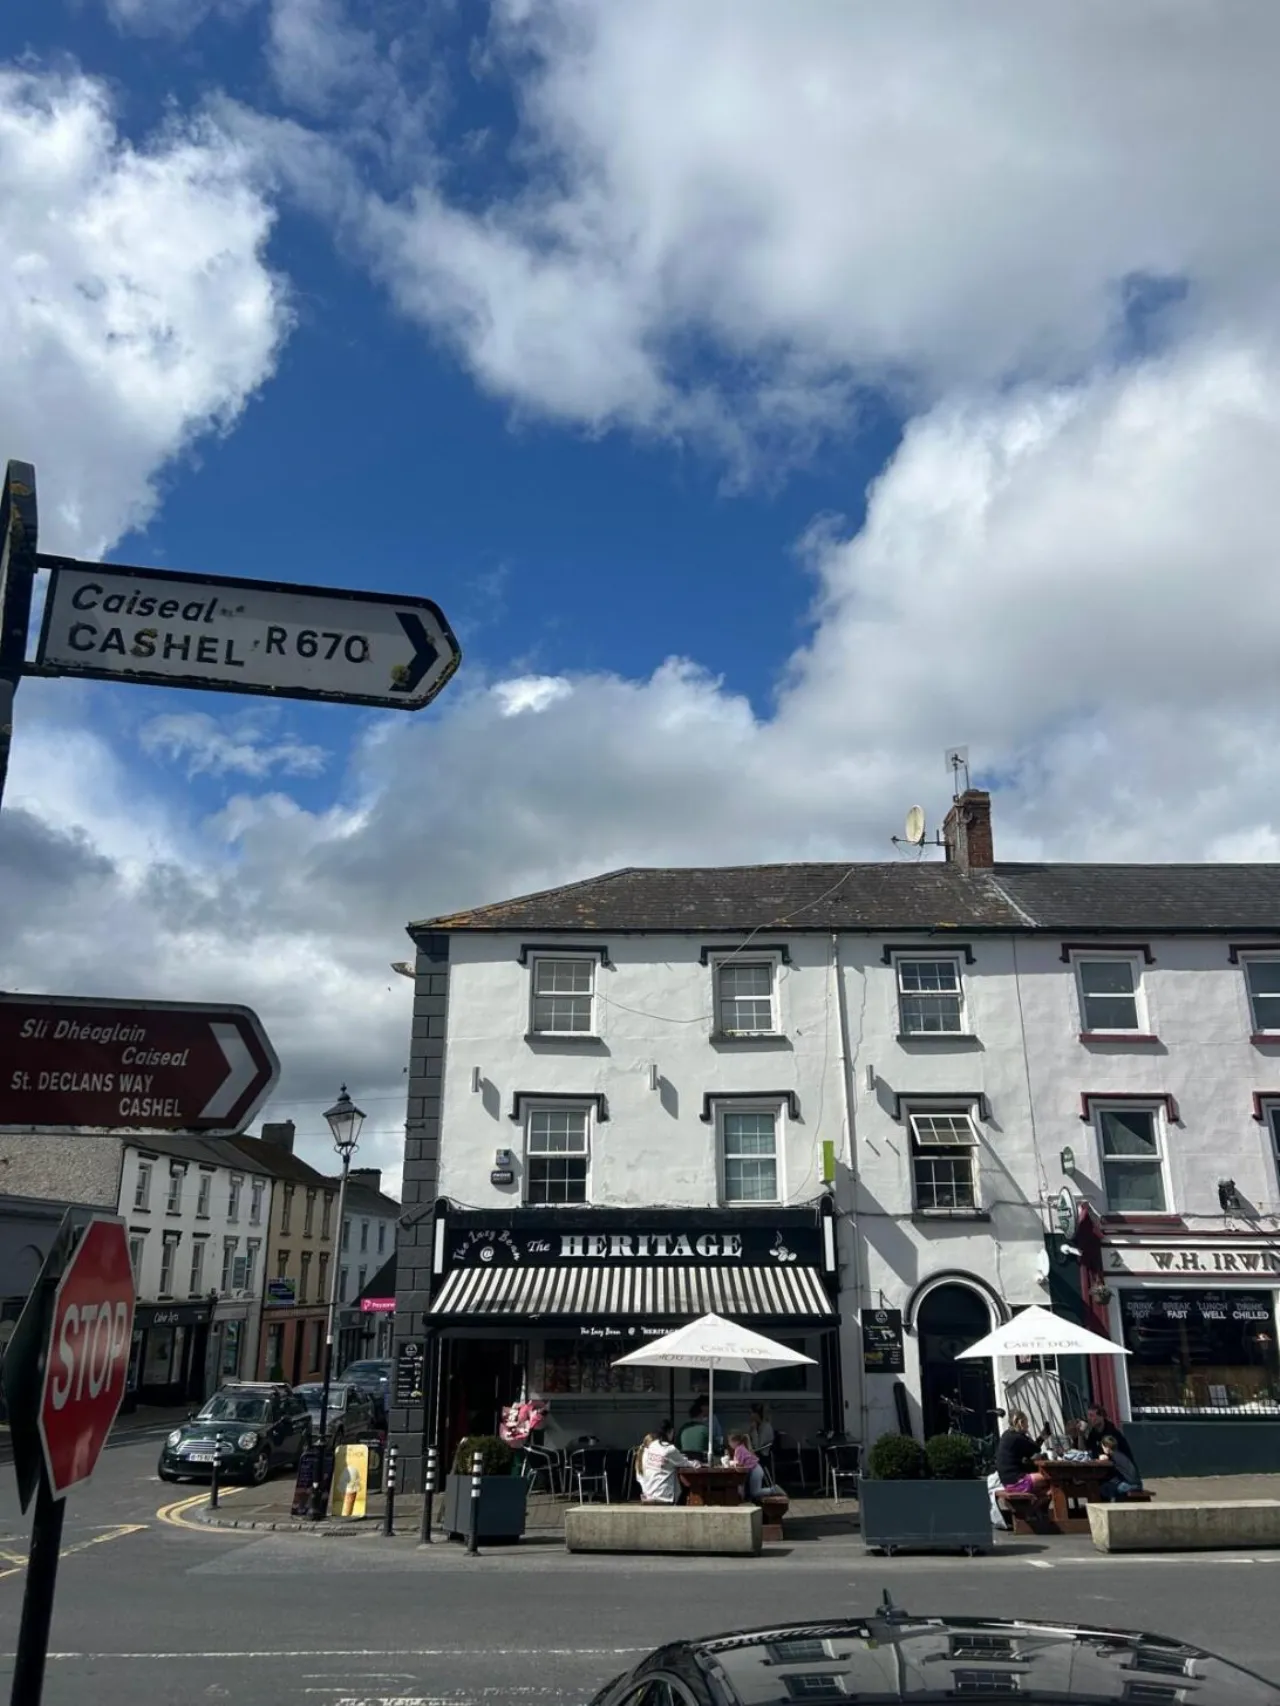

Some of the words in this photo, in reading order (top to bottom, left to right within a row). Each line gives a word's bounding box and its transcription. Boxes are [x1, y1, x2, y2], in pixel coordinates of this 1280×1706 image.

[71, 582, 218, 623] Caiseal
[68, 621, 245, 667] CASHEL
[19, 1018, 49, 1038] Slí
[53, 1020, 147, 1044] Dhéagláin
[121, 1046, 190, 1066] Caiseal
[11, 1071, 32, 1090] St.
[38, 1071, 115, 1092] DECLANS
[119, 1073, 153, 1093] WAY
[119, 1097, 182, 1117] CASHEL
[452, 1242, 469, 1260] The
[480, 1246, 495, 1262] @
[527, 1239, 551, 1252] The
[559, 1234, 743, 1258] HERITAGE
[1150, 1252, 1207, 1270] W.H.
[1162, 1301, 1192, 1310] BREAK
[1167, 1310, 1189, 1319] FAST
[1197, 1301, 1228, 1310] LUNCH
[1202, 1310, 1227, 1319] WELL
[1232, 1310, 1269, 1320] CHILLED
[52, 1301, 128, 1410] STOP
